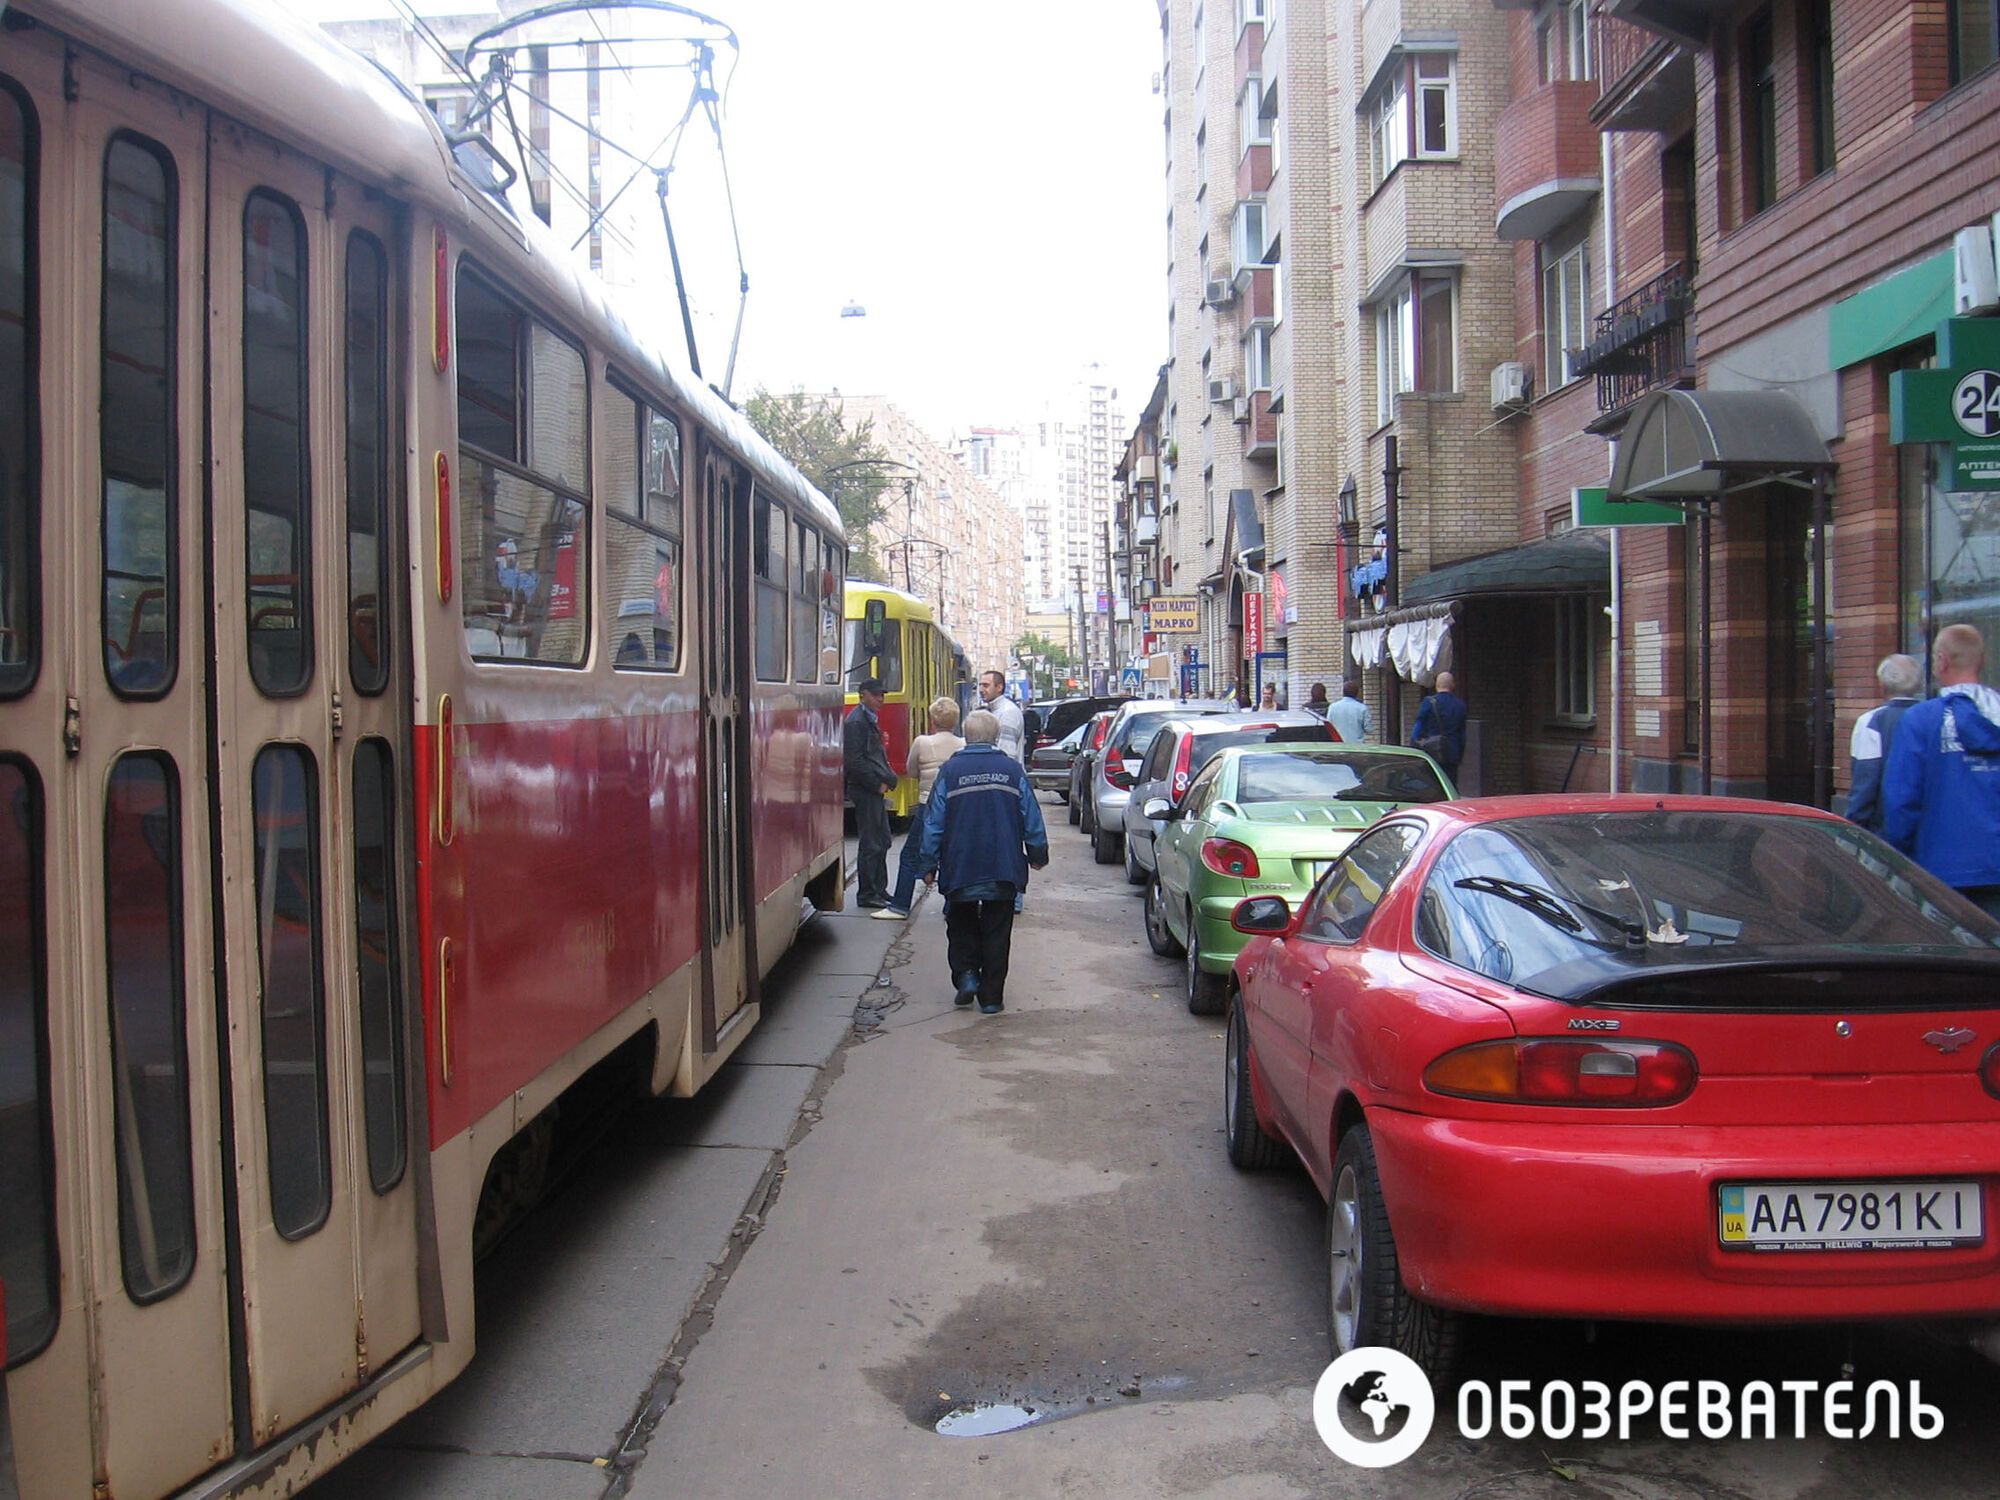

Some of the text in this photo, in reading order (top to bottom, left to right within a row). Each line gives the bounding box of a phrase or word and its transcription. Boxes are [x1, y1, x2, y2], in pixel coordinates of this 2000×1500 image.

[1169, 601, 1196, 611] МАРКЕТ
[1154, 619, 1194, 628] МАРКО
[1567, 1018, 1621, 1030] MX-3
[1726, 1222, 1743, 1232] UA
[1784, 1242, 1821, 1250] Autohaus
[1825, 1241, 1862, 1249] HELLWIG
[1872, 1240, 1924, 1249] Hoyerswerda
